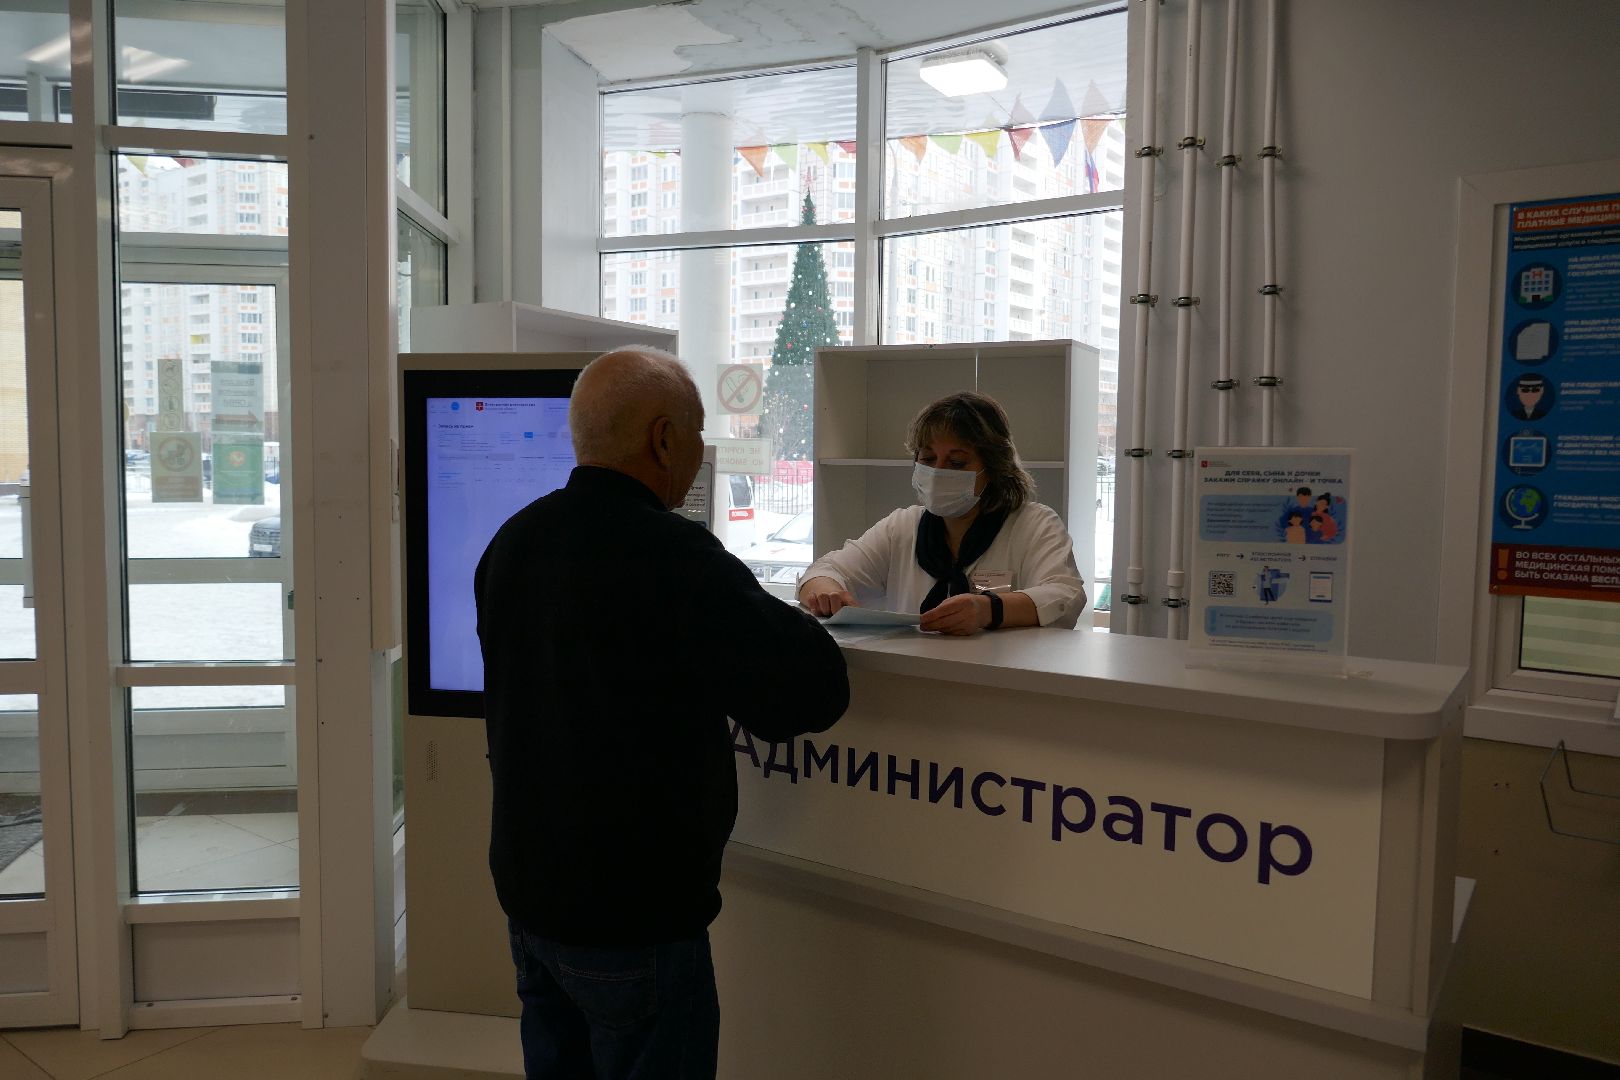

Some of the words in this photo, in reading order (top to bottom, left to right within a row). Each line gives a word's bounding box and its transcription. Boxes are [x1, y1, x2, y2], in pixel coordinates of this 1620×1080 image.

[1526, 208, 1559, 219] КАКИХ
[1561, 204, 1609, 216] СЛУЧАЯХ
[1517, 217, 1567, 228] ПЛАТНЫЕ
[1516, 551, 1530, 559] ВО
[1531, 552, 1557, 560] ВСЕХ
[1515, 561, 1590, 572] МЕДИЦИНСКАЯ
[1514, 570, 1540, 579] БЫТЬ
[1542, 572, 1589, 582] ОКАЗАНА
[1591, 575, 1620, 584] БЕСП
[731, 720, 1313, 884] Администратор
